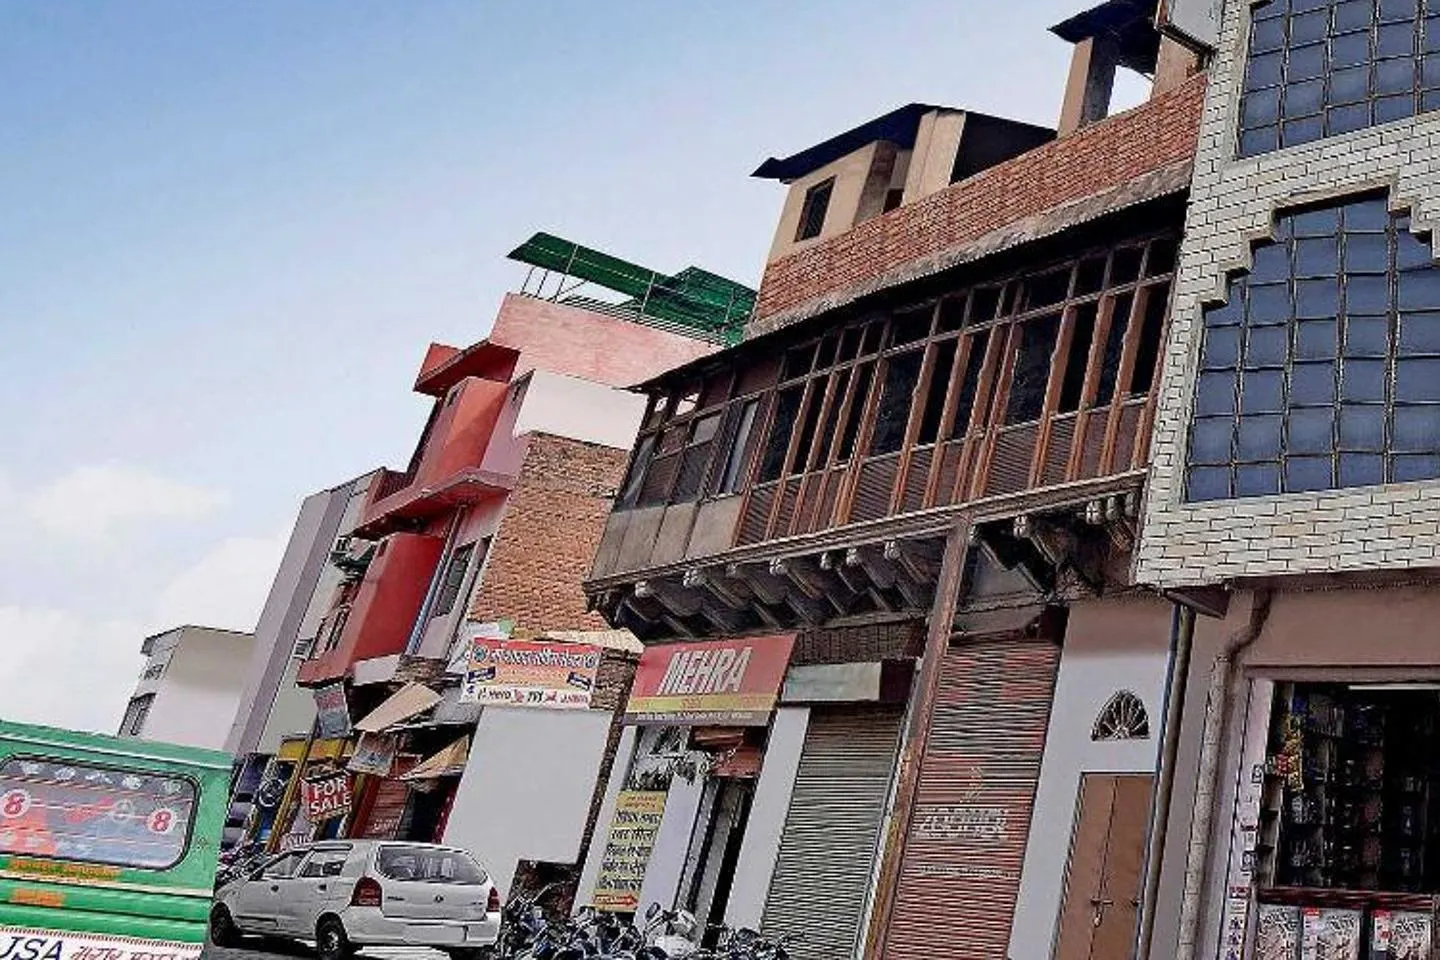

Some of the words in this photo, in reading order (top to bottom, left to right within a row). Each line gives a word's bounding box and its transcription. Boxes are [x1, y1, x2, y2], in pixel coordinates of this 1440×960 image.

[656, 646, 753, 696] MEHRA
[312, 777, 347, 800] FOR
[4, 792, 25, 816] 8
[310, 791, 352, 815] SALE
[152, 810, 172, 832] 8
